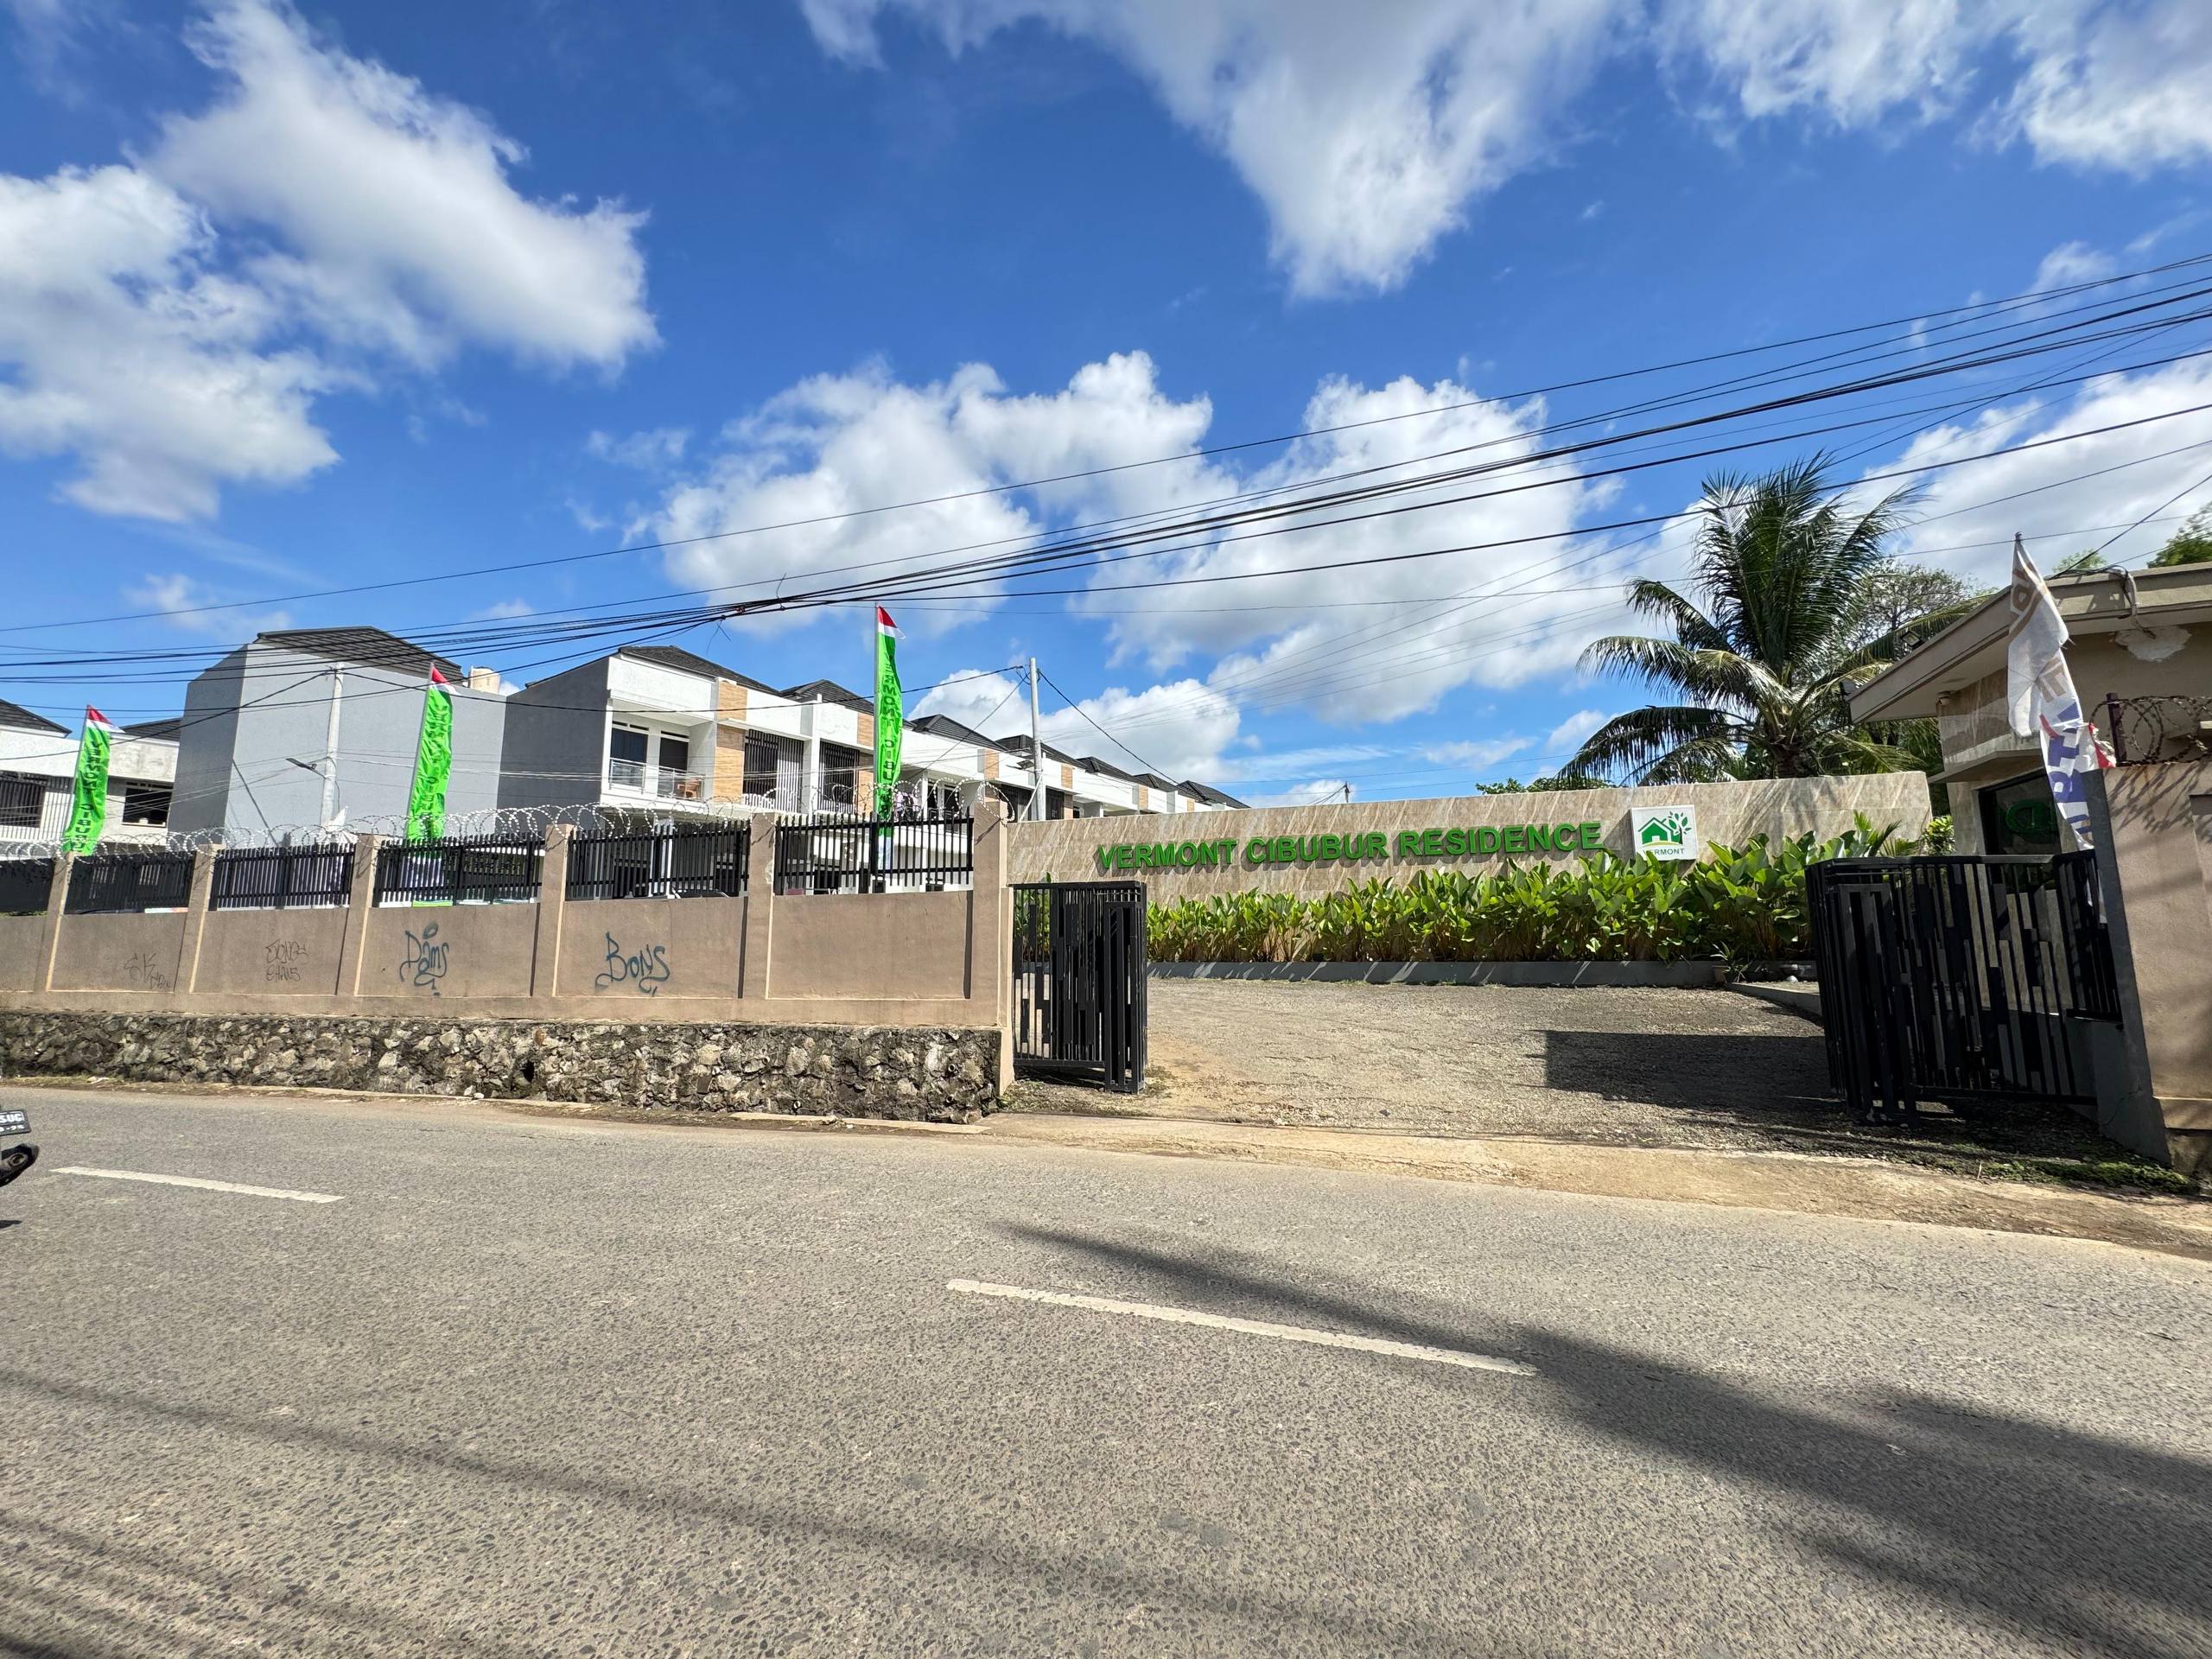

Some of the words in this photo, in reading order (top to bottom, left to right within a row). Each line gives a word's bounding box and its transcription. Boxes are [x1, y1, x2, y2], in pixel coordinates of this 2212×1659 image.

[1097, 837, 1238, 869] VERMONT
[1246, 830, 1389, 864] CIBUBUR
[1399, 822, 1605, 857] RESIDENCE
